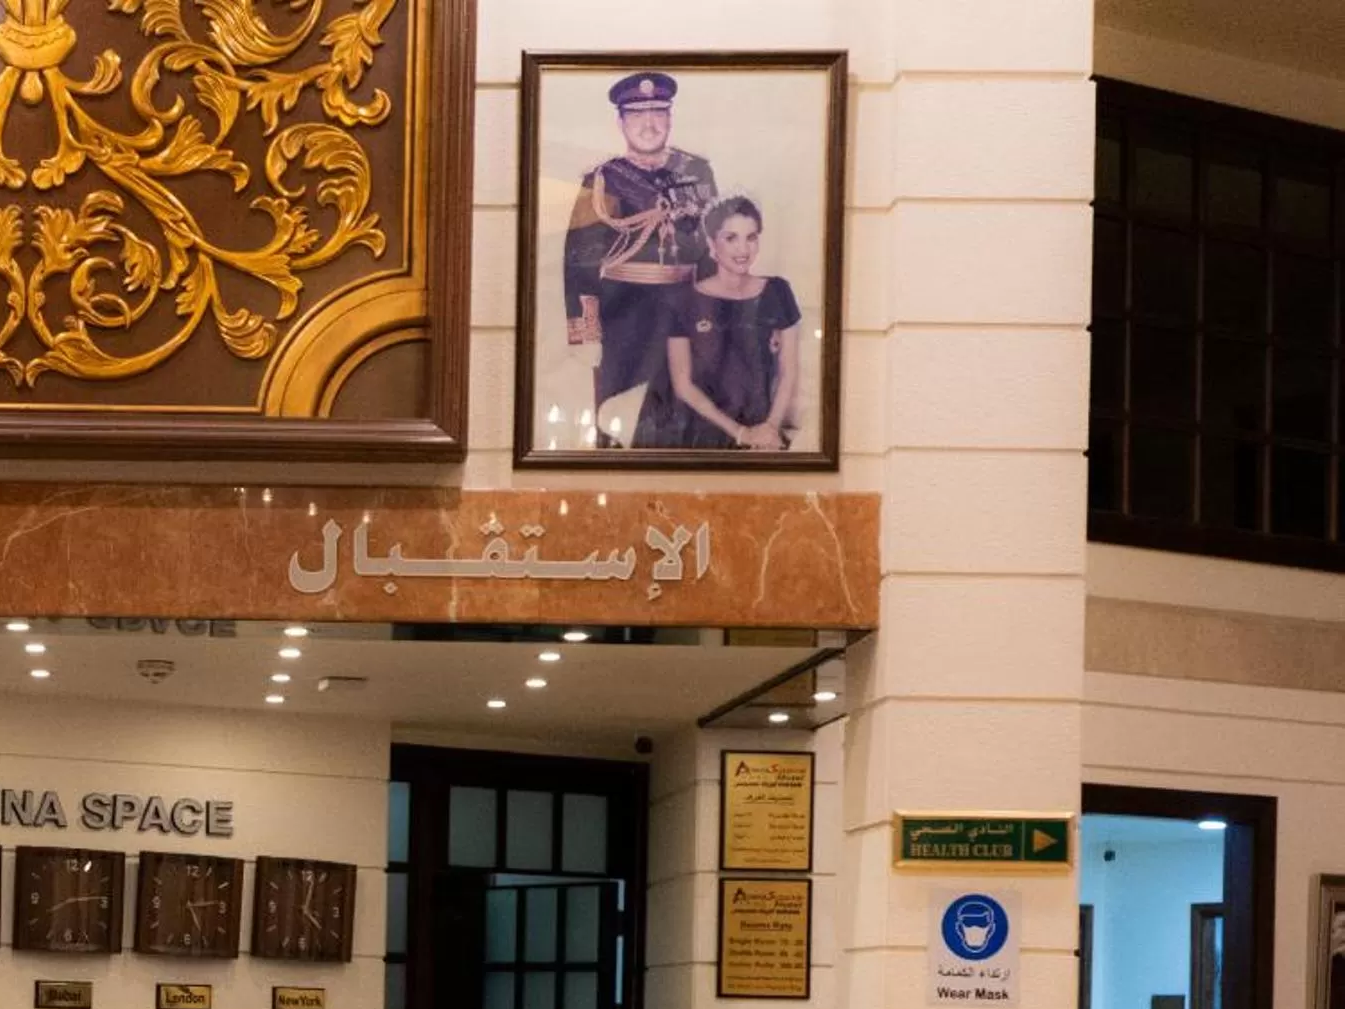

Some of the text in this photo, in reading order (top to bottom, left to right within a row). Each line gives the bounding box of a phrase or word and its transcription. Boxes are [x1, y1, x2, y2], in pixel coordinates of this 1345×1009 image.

[287, 517, 711, 601] الإستقبال
[80, 792, 235, 838] SPACE
[910, 843, 1014, 858] HEALTH CLUB
[186, 864, 200, 878] 12
[165, 990, 205, 1004] London
[936, 986, 1009, 1001] Wear Mask
